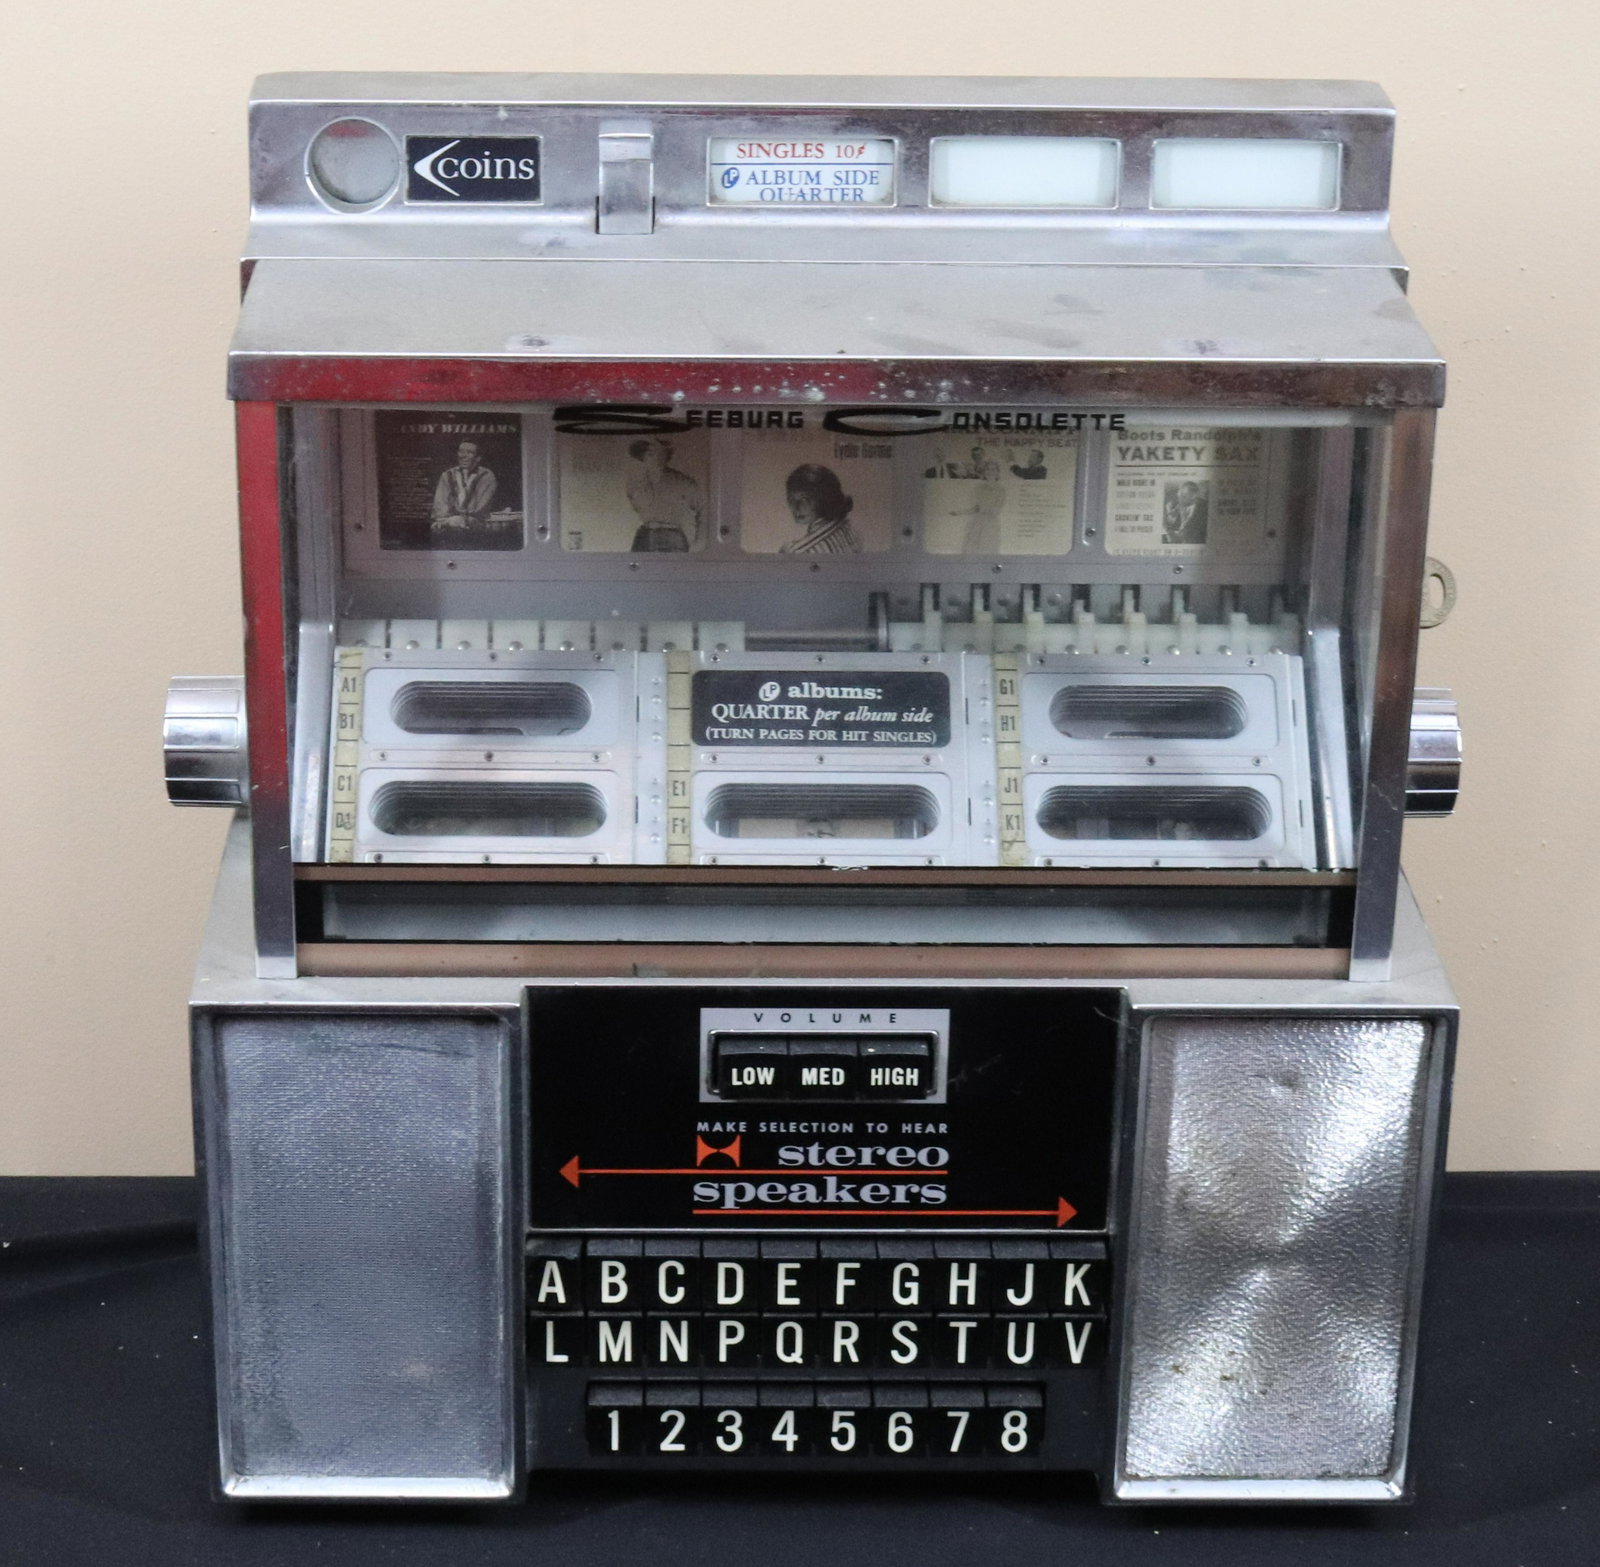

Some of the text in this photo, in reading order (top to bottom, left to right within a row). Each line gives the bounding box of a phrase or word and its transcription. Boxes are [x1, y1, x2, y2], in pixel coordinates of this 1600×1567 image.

[736, 143, 825, 159] SINGLES
[437, 150, 535, 181] coins
[746, 170, 822, 186] ALBUM
[833, 170, 880, 186] SIDE
[760, 188, 864, 202] QUARTER
[441, 424, 518, 434] WILLIAMS
[552, 404, 1126, 437] SEEBURG CONSOLETTE
[1117, 446, 1259, 461] YAKETY SAX
[341, 677, 357, 693] A1
[788, 682, 883, 700] albums:
[999, 679, 1015, 695] G1
[340, 713, 355, 729] B1
[711, 704, 934, 727] QUARTER per album side
[1000, 715, 1016, 731] H1
[705, 726, 937, 745] (TURN PAGES FOR HIT SINGLES)
[337, 775, 353, 791] C1
[672, 780, 686, 796] E1
[1004, 777, 1019, 794] J1
[672, 817, 686, 834] F1
[1005, 813, 1021, 831] K1
[754, 1012, 898, 1024] VOLUME
[731, 1067, 919, 1086] LOW MED HIGH
[697, 1121, 948, 1134] MAKE SELECTION TO HEAR
[778, 1141, 949, 1167] stereo
[693, 1176, 947, 1209] speakers
[538, 1261, 1090, 1305] A B C D E F G H J K
[545, 1321, 1090, 1364] L M N P Q R S T U V
[607, 1410, 1027, 1452] 1 2 3 4 5 6 7 8
